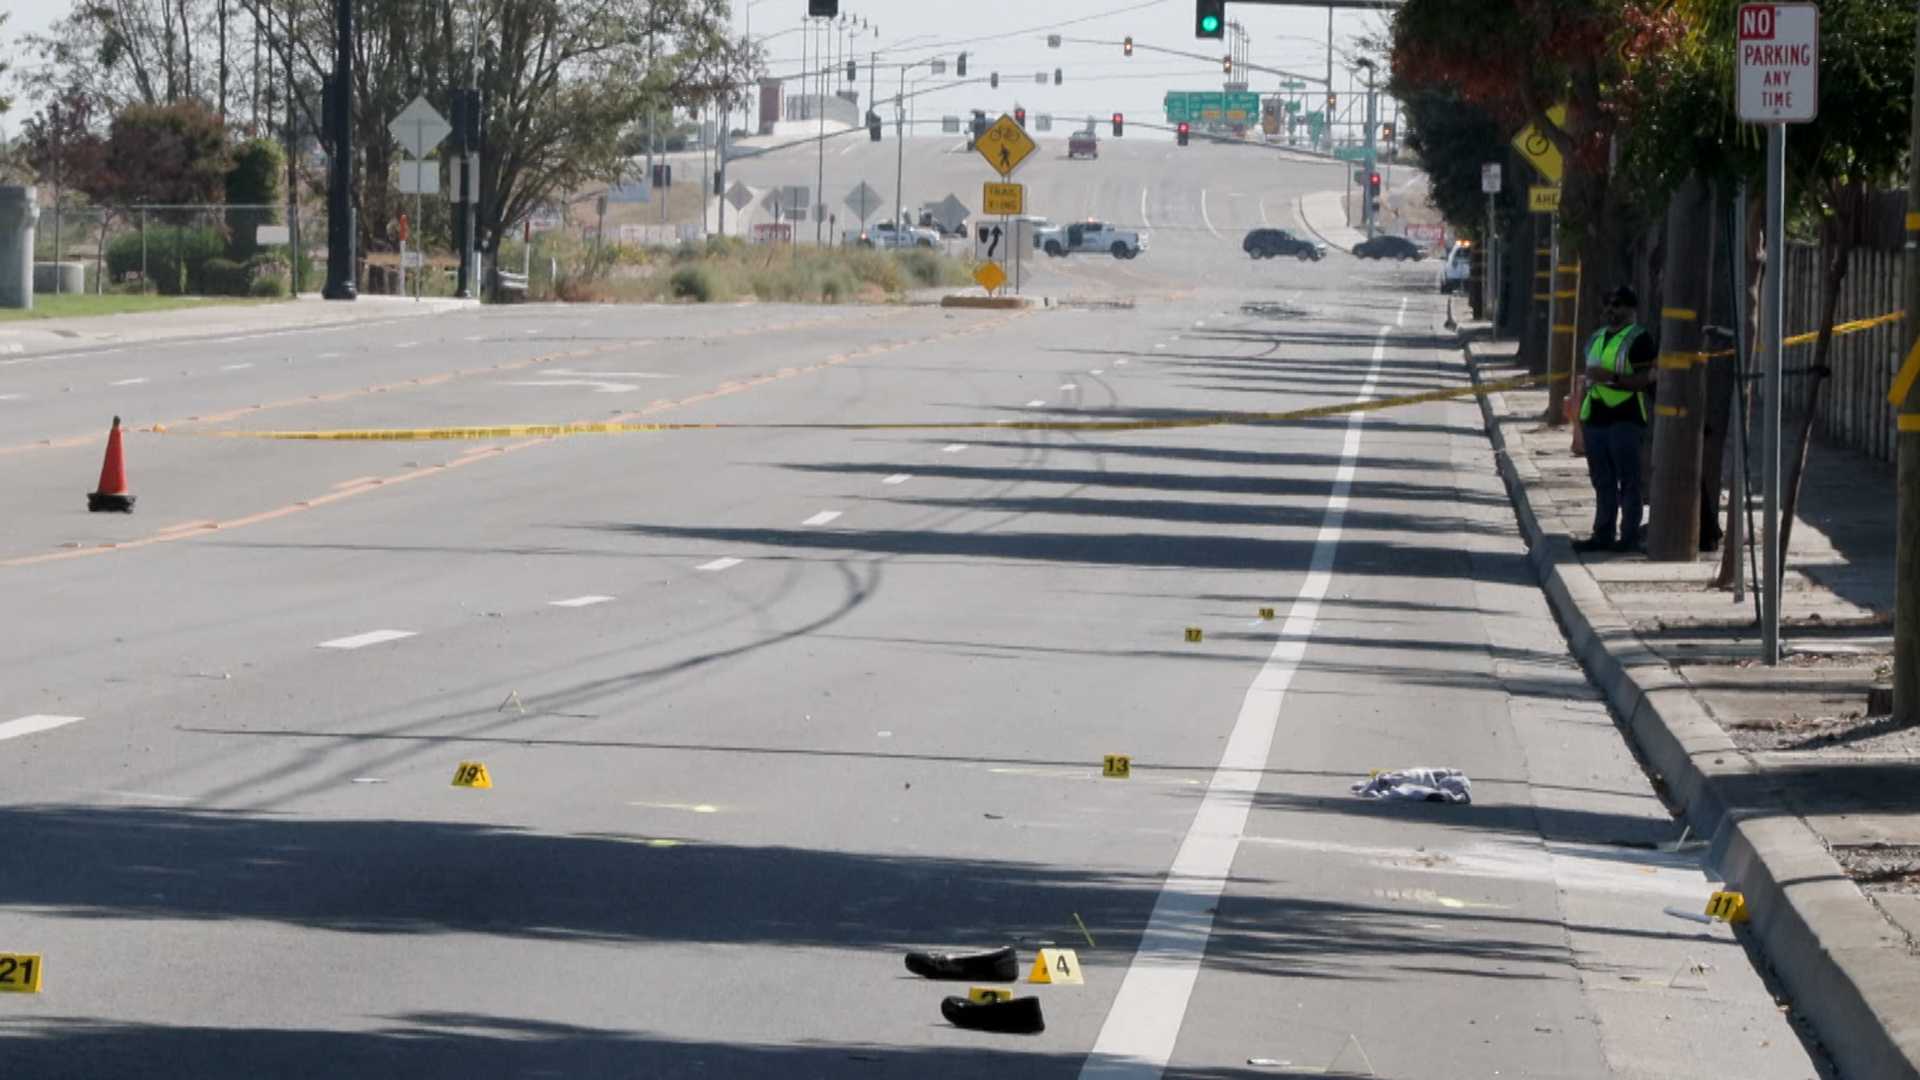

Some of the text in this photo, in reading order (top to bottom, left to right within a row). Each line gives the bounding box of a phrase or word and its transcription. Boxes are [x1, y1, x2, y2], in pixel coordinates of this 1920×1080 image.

[1743, 9, 1771, 35] NO
[1744, 44, 1811, 66] PARKING
[1763, 70, 1791, 87] ANY
[1762, 91, 1793, 108] TIME
[1185, 629, 1202, 641] 17
[1105, 756, 1129, 772] 13
[458, 765, 478, 783] 19
[1713, 896, 1732, 914] 11
[0, 957, 33, 984] 21
[1056, 954, 1070, 977] 4
